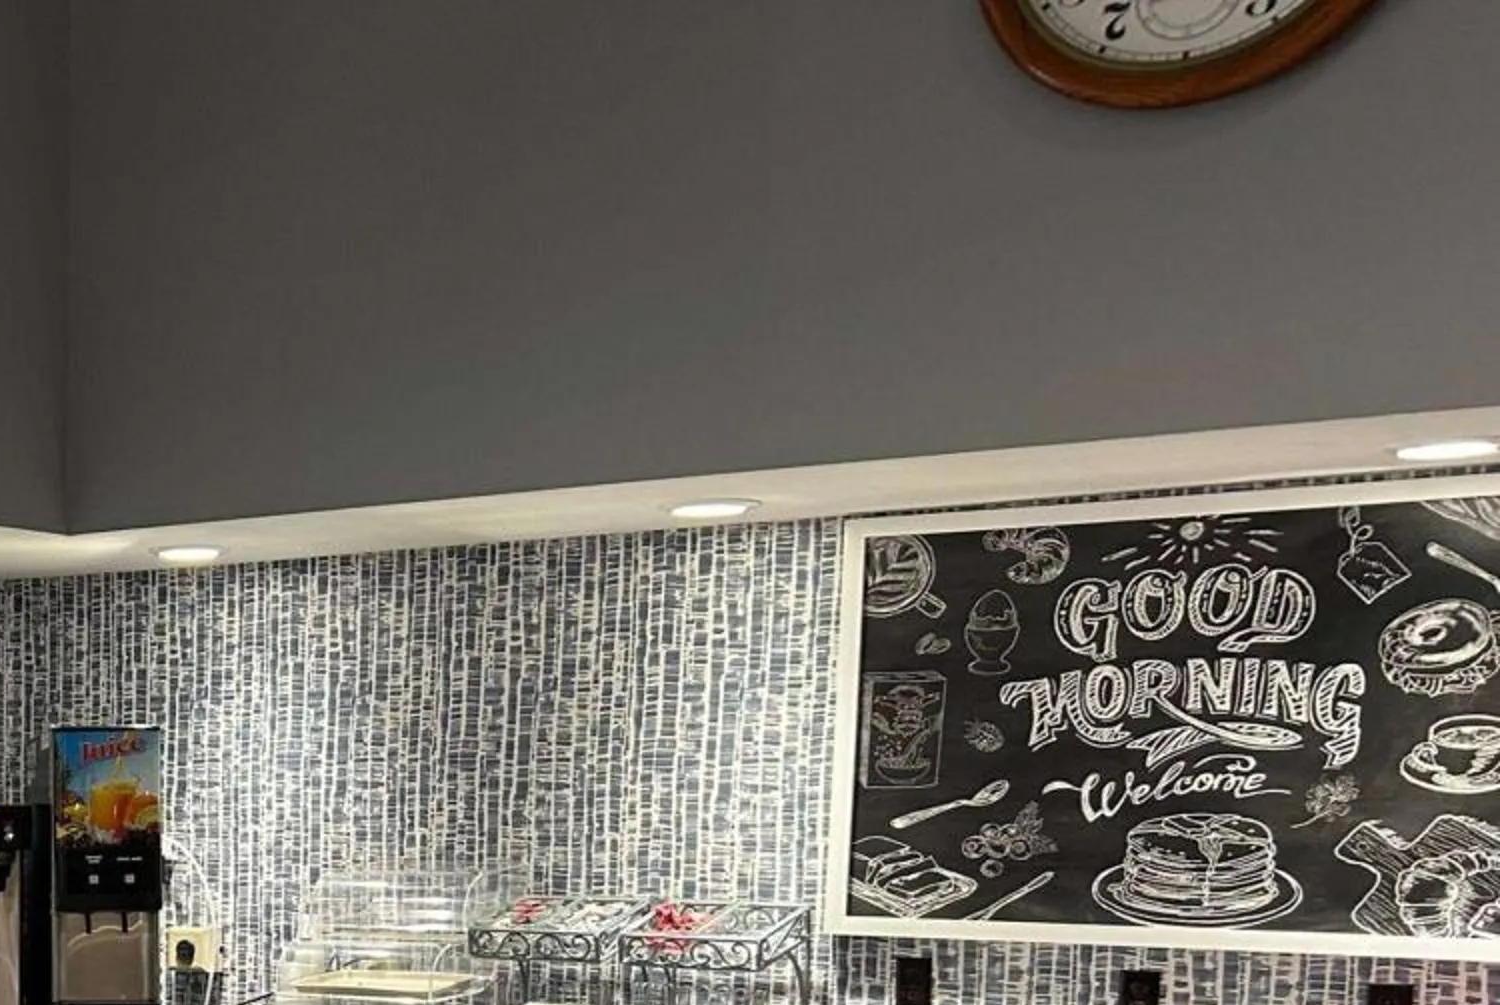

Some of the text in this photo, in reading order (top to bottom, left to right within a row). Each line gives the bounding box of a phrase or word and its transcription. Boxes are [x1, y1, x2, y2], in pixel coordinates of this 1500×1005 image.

[1054, 566, 1316, 660] GOOD
[1001, 657, 1366, 768] MORNING
[1043, 754, 1292, 822] Welcome
